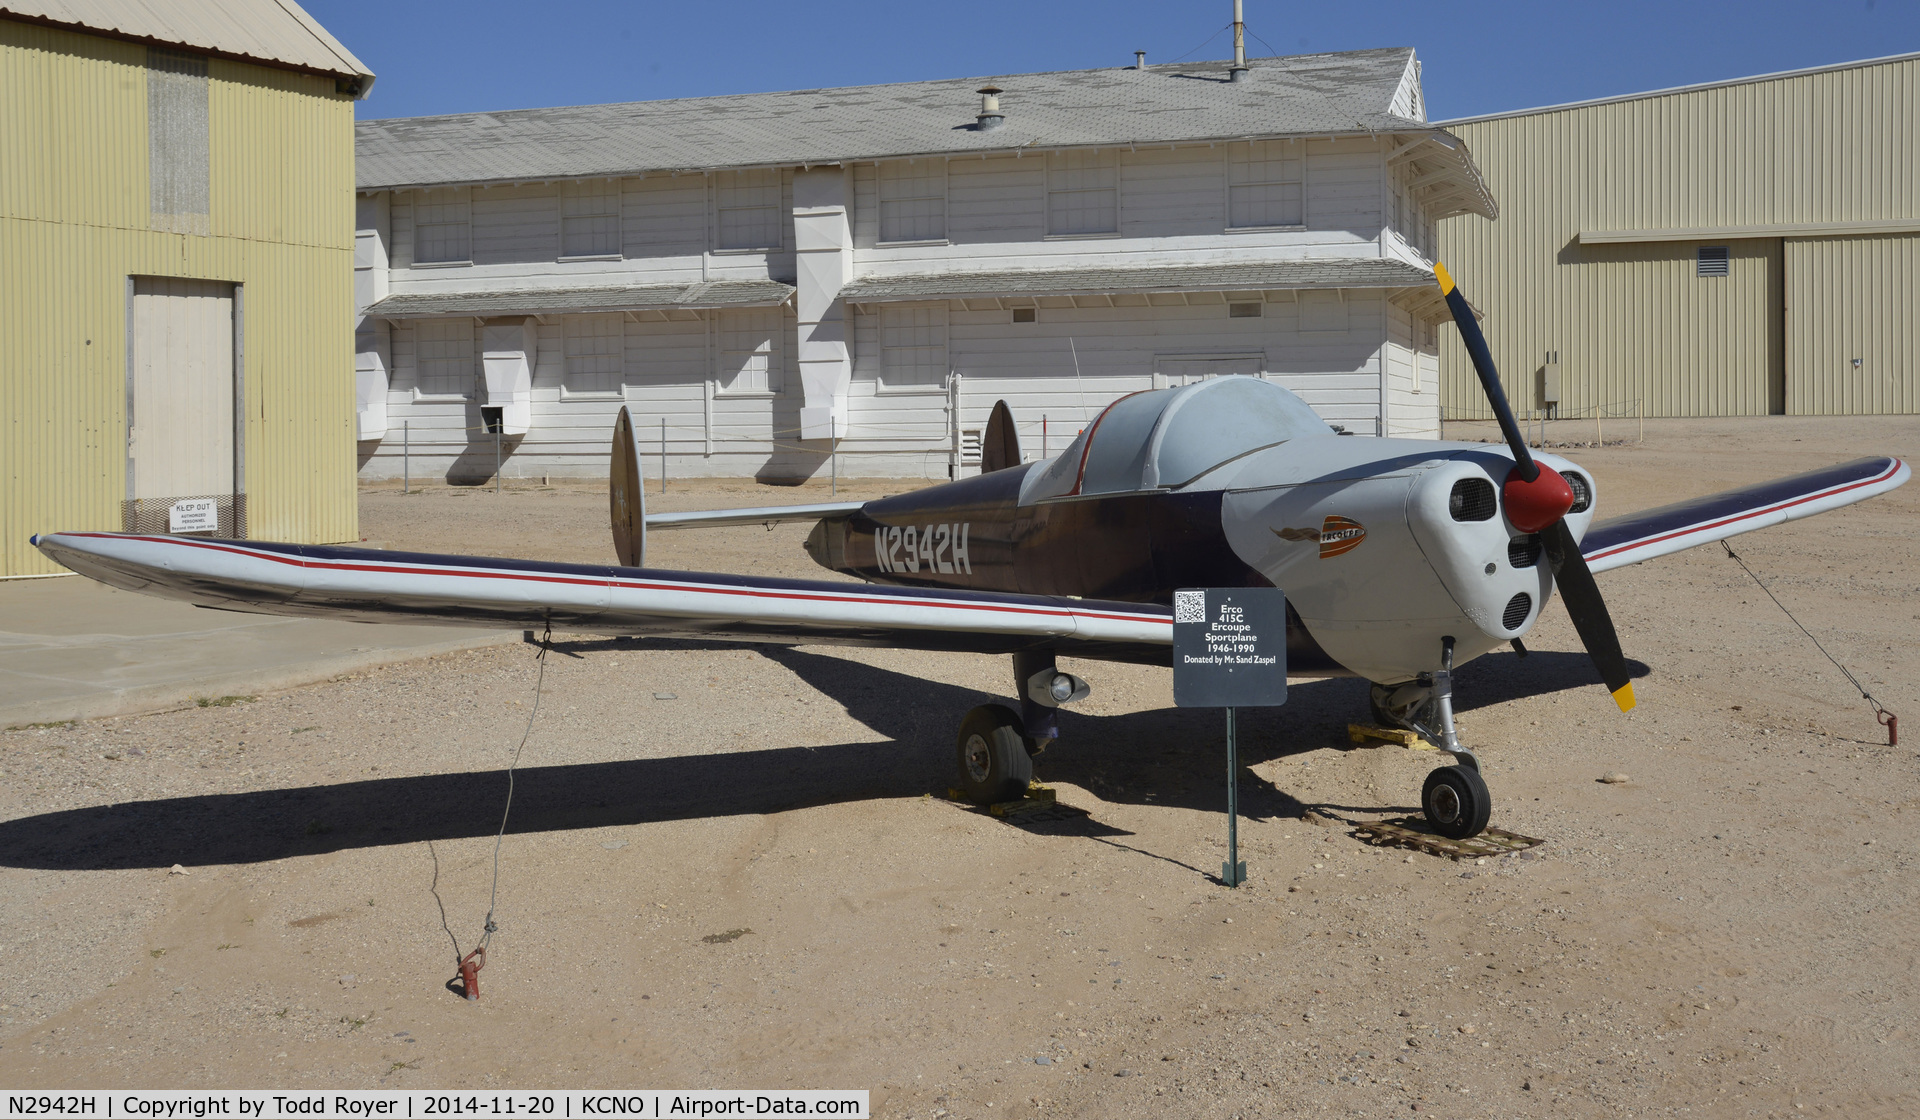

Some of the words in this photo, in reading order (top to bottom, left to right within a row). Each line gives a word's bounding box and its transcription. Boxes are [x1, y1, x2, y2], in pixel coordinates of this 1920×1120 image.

[874, 522, 972, 575] N2942H
[1221, 604, 1243, 614] Erco
[1219, 614, 1244, 622] 415C
[1211, 622, 1251, 633] Ercoupe
[1205, 633, 1257, 643] Sportplane
[1208, 644, 1255, 653] 1946-1990
[1184, 655, 1213, 664] Donated
[1214, 655, 1223, 666] by
[1224, 655, 1236, 664] Mr.
[1236, 655, 1253, 664] Sand
[1253, 655, 1276, 666] Zaspel
